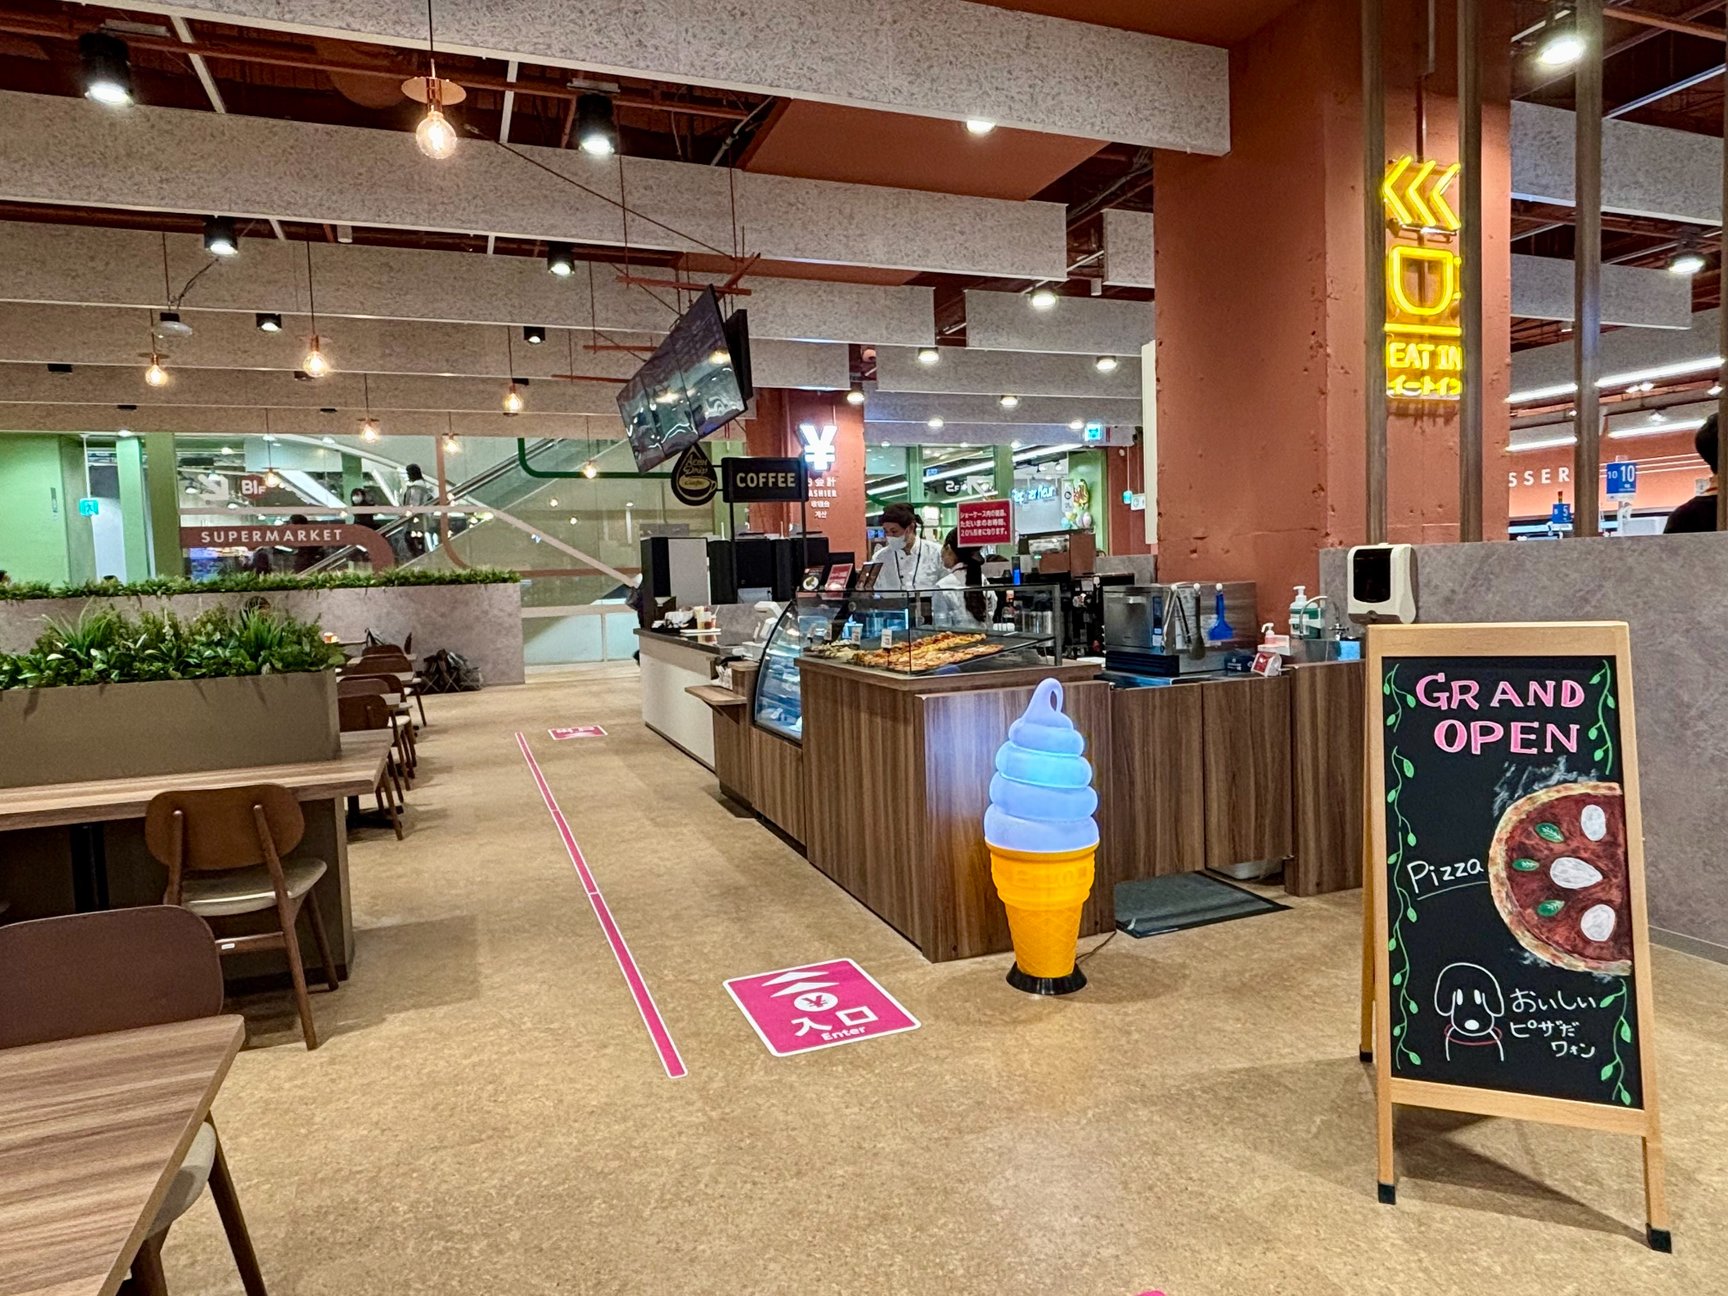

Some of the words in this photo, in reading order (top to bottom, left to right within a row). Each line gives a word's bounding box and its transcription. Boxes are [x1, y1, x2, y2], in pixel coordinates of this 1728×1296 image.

[1389, 342, 1435, 370] EAT
[1435, 345, 1462, 371] IN
[736, 472, 796, 488] COFFEE
[1508, 467, 1570, 488] SSER
[1620, 465, 1635, 482] 10
[808, 489, 837, 498] ASHIER
[201, 529, 342, 543] SUPERMARKET
[1415, 672, 1585, 711] GRAND
[1433, 719, 1580, 755] OPEN
[1407, 858, 1484, 894] Pizza
[1509, 988, 1597, 1013] おいしい
[791, 1005, 879, 1037] 入口
[1510, 1019, 1580, 1038] ピザだ
[821, 1025, 866, 1042] Enter
